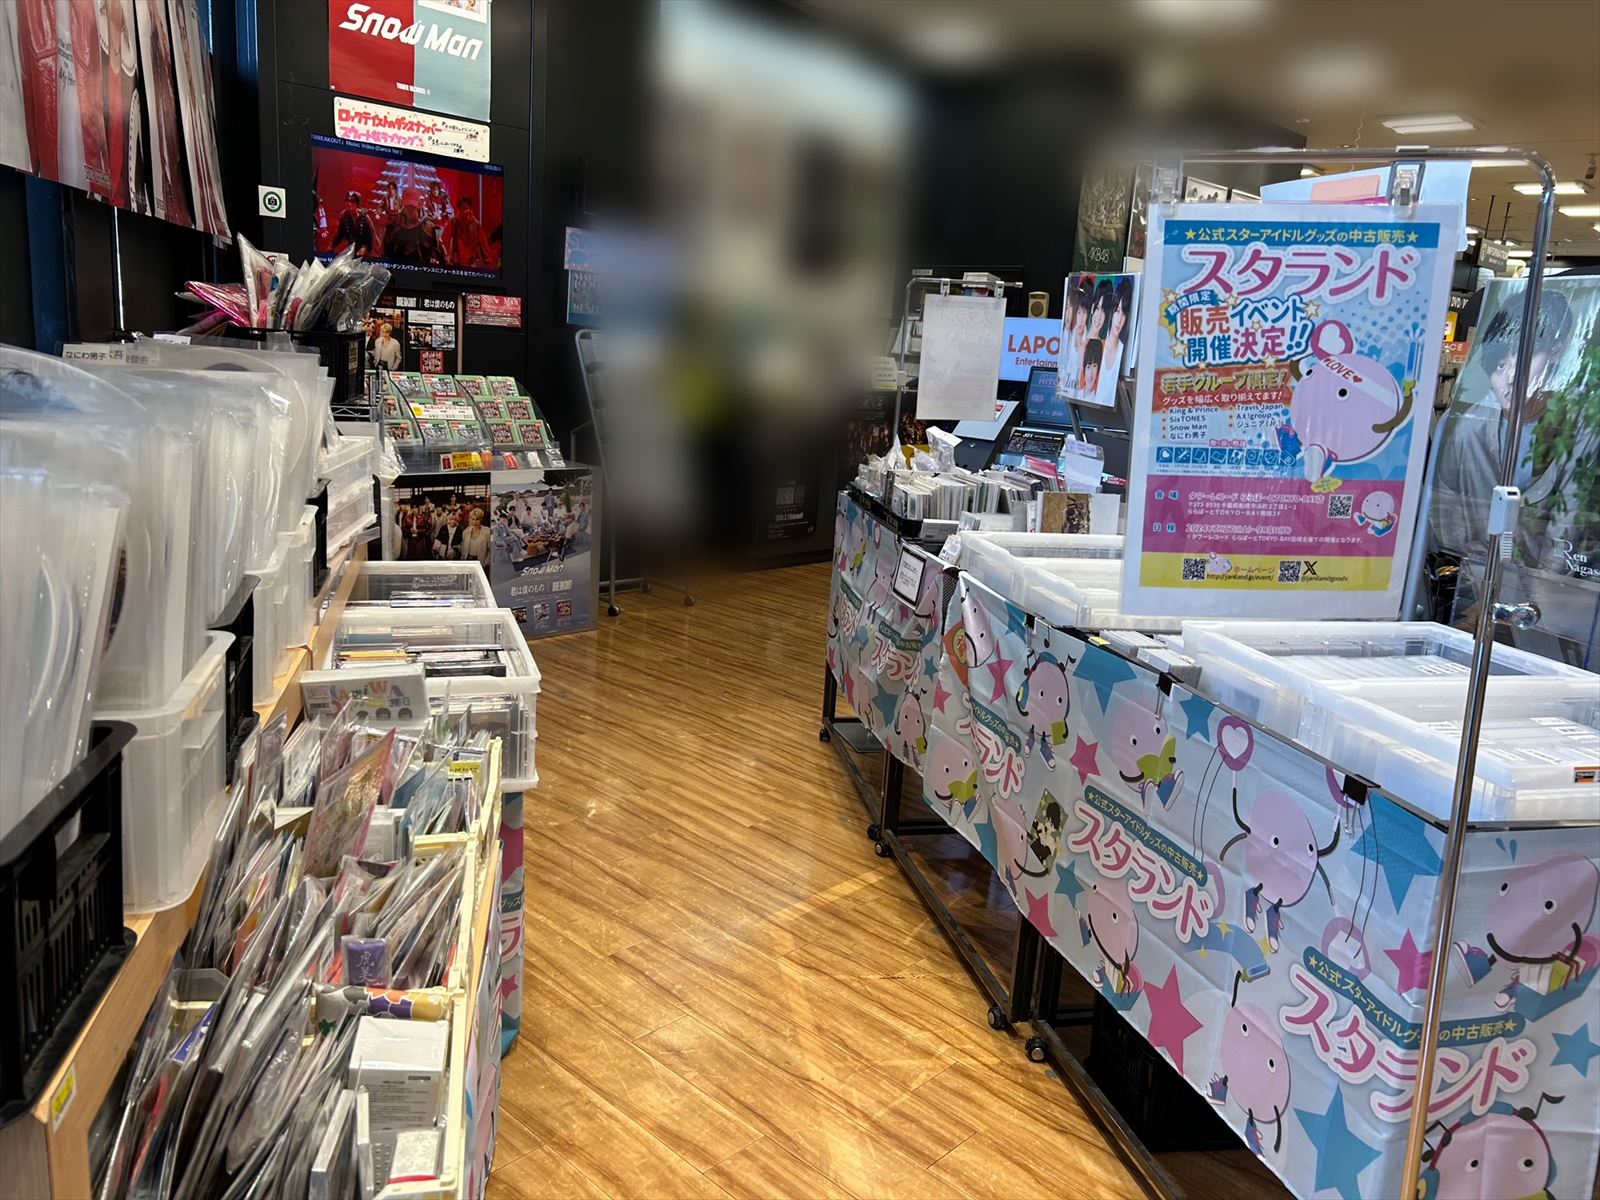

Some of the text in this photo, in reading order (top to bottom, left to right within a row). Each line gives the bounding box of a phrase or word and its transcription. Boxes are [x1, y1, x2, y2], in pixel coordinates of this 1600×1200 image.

[339, 3, 483, 61] Snow Man
[1198, 226, 1405, 245] 公式スターアイドルグッズの中古販売
[1182, 247, 1415, 299] スタランド
[1166, 290, 1212, 316] 期間限定
[1179, 297, 1308, 337] 販売イベント
[65, 351, 107, 360] なにわ男子
[1325, 359, 1356, 380] LOVE
[1169, 408, 1186, 416] King
[1195, 406, 1219, 414] Prince
[1237, 403, 1284, 413] Travis Japan
[1169, 415, 1207, 423] SixTONES
[1169, 432, 1207, 440] なにわ男子
[1552, 537, 1588, 563] Ren
[521, 564, 564, 576] Snow Man
[1234, 565, 1276, 573] ホームページ
[1093, 794, 1199, 878] 公式スターアイドルグッズの中古販売
[1071, 806, 1209, 935] スタランド
